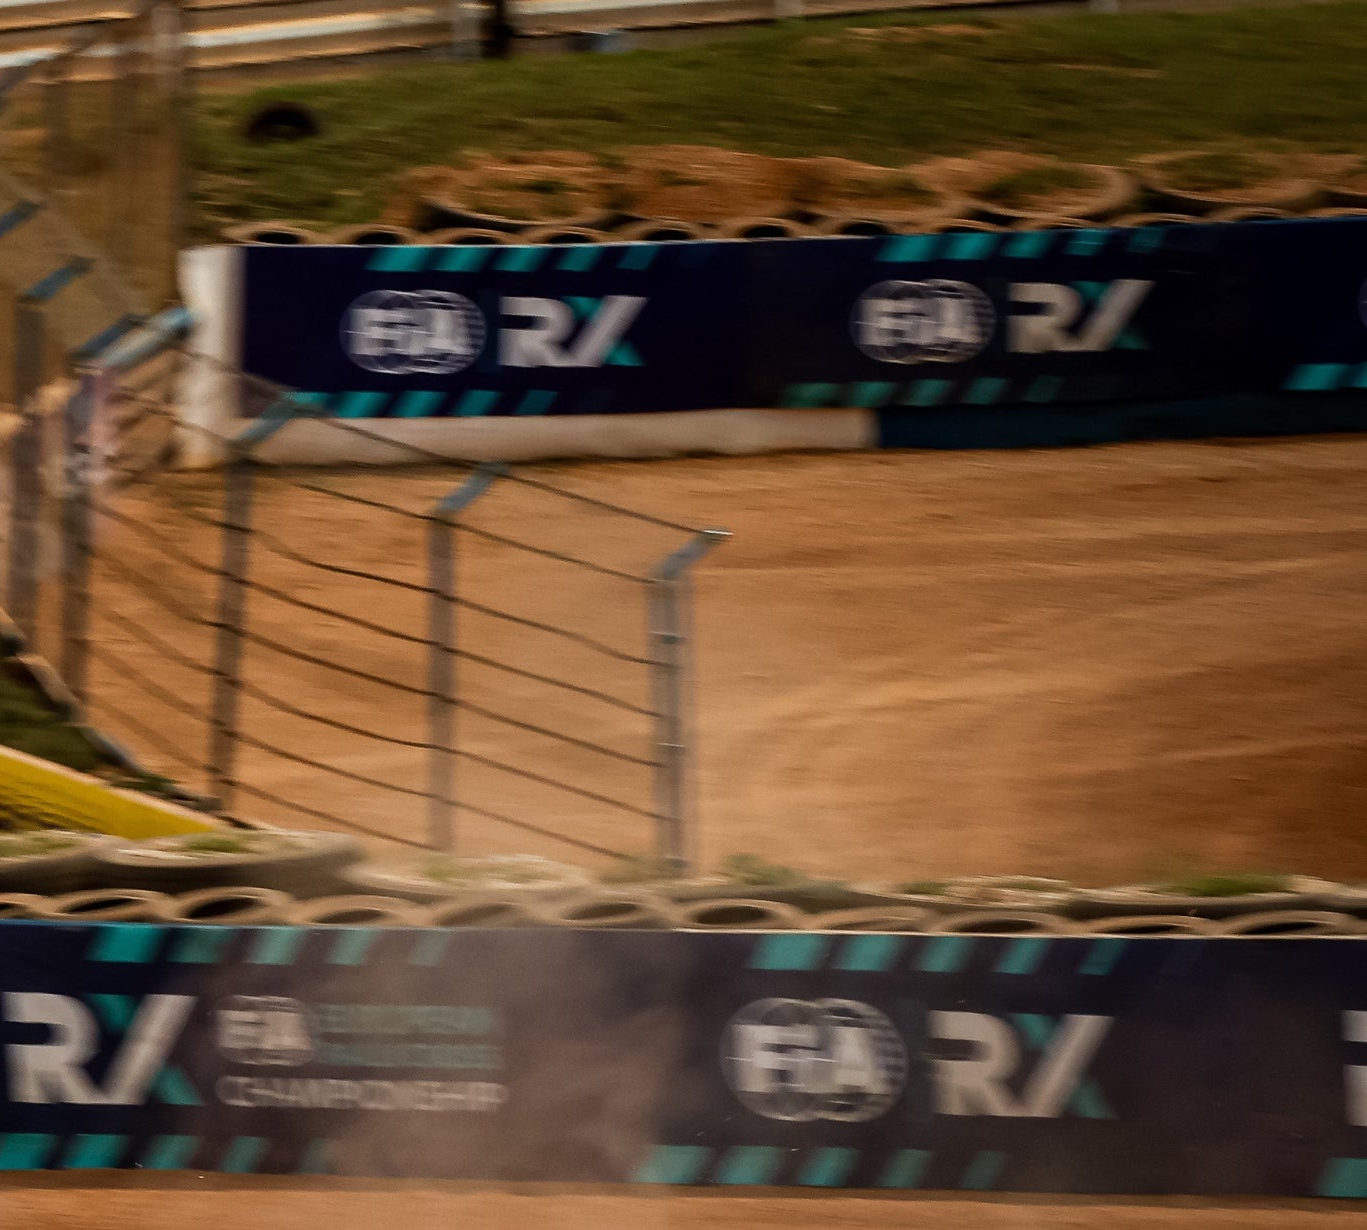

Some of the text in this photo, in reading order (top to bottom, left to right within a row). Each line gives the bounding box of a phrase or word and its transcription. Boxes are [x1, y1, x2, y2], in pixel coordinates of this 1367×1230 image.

[498, 294, 647, 367] RX
[1006, 278, 1153, 355] RX
[4, 990, 203, 1105] RX
[928, 1013, 1118, 1119] RX
